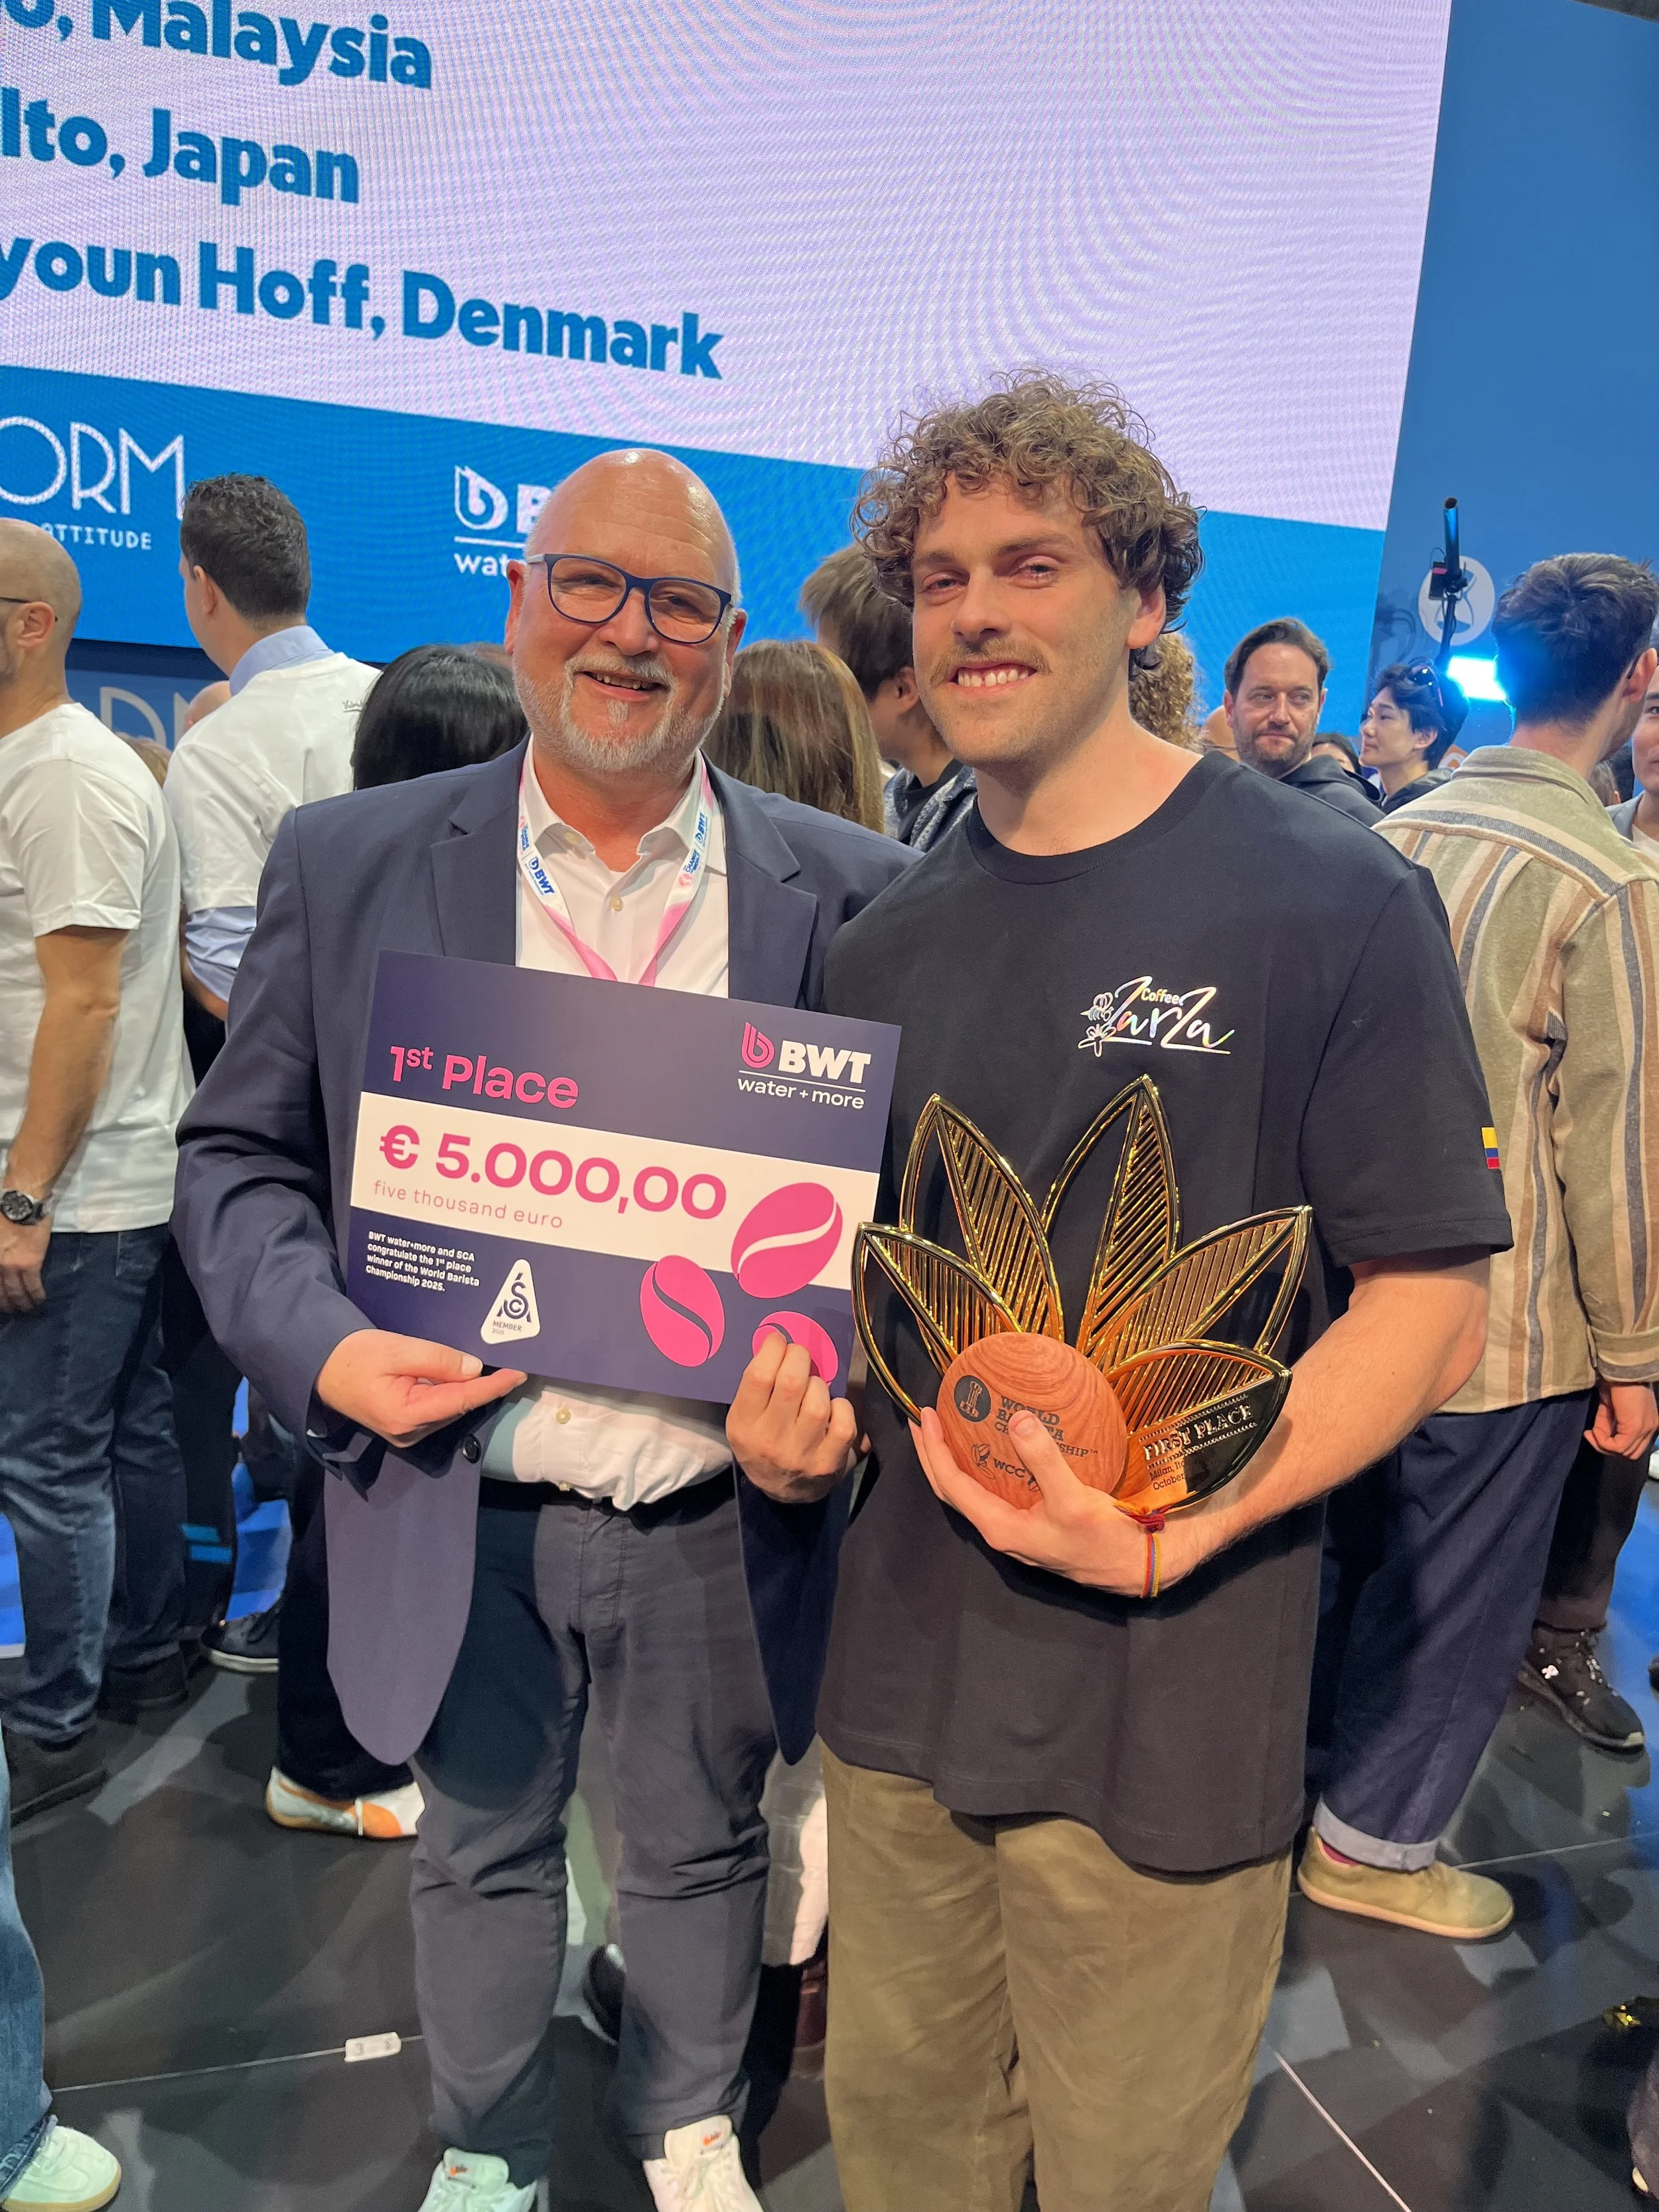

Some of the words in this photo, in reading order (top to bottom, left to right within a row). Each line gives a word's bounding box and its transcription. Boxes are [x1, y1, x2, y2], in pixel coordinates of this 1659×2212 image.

[92, 0, 432, 89] Malaysia
[143, 108, 359, 206] Japan
[199, 241, 386, 340] Hoff,
[403, 271, 724, 380] Denmark
[534, 869, 555, 893] BWT
[1141, 988, 1180, 1005] Coffee
[390, 1045, 433, 1082] 1st
[442, 1055, 579, 1108] Place
[778, 1040, 871, 1084] BWT
[737, 1078, 796, 1098] water
[812, 1090, 865, 1110] more
[380, 1125, 420, 1169] €
[436, 1133, 727, 1219] 5.000,00
[374, 1179, 406, 1201] five
[413, 1189, 507, 1219] thousand
[514, 1211, 563, 1228] euro
[368, 1230, 386, 1242] BWT
[388, 1234, 436, 1254] water+more
[437, 1247, 455, 1258] and
[457, 1250, 475, 1262] SCA
[368, 1242, 418, 1262] congratulate
[419, 1254, 433, 1265] the
[435, 1257, 445, 1267] 1st
[446, 1260, 472, 1274] place
[366, 1264, 420, 1287] Championship
[421, 1279, 445, 1292] 2025.
[367, 1254, 393, 1268] winner
[394, 1260, 404, 1270] of
[404, 1262, 418, 1274] the
[420, 1267, 445, 1280] World
[447, 1272, 480, 1286] Barista
[492, 1320, 522, 1332] MEMBER
[1143, 1428, 1191, 1461] FIRST
[1194, 1404, 1254, 1439] PLACE
[1149, 1465, 1175, 1481] Milan,
[1153, 1473, 1185, 1490] October
